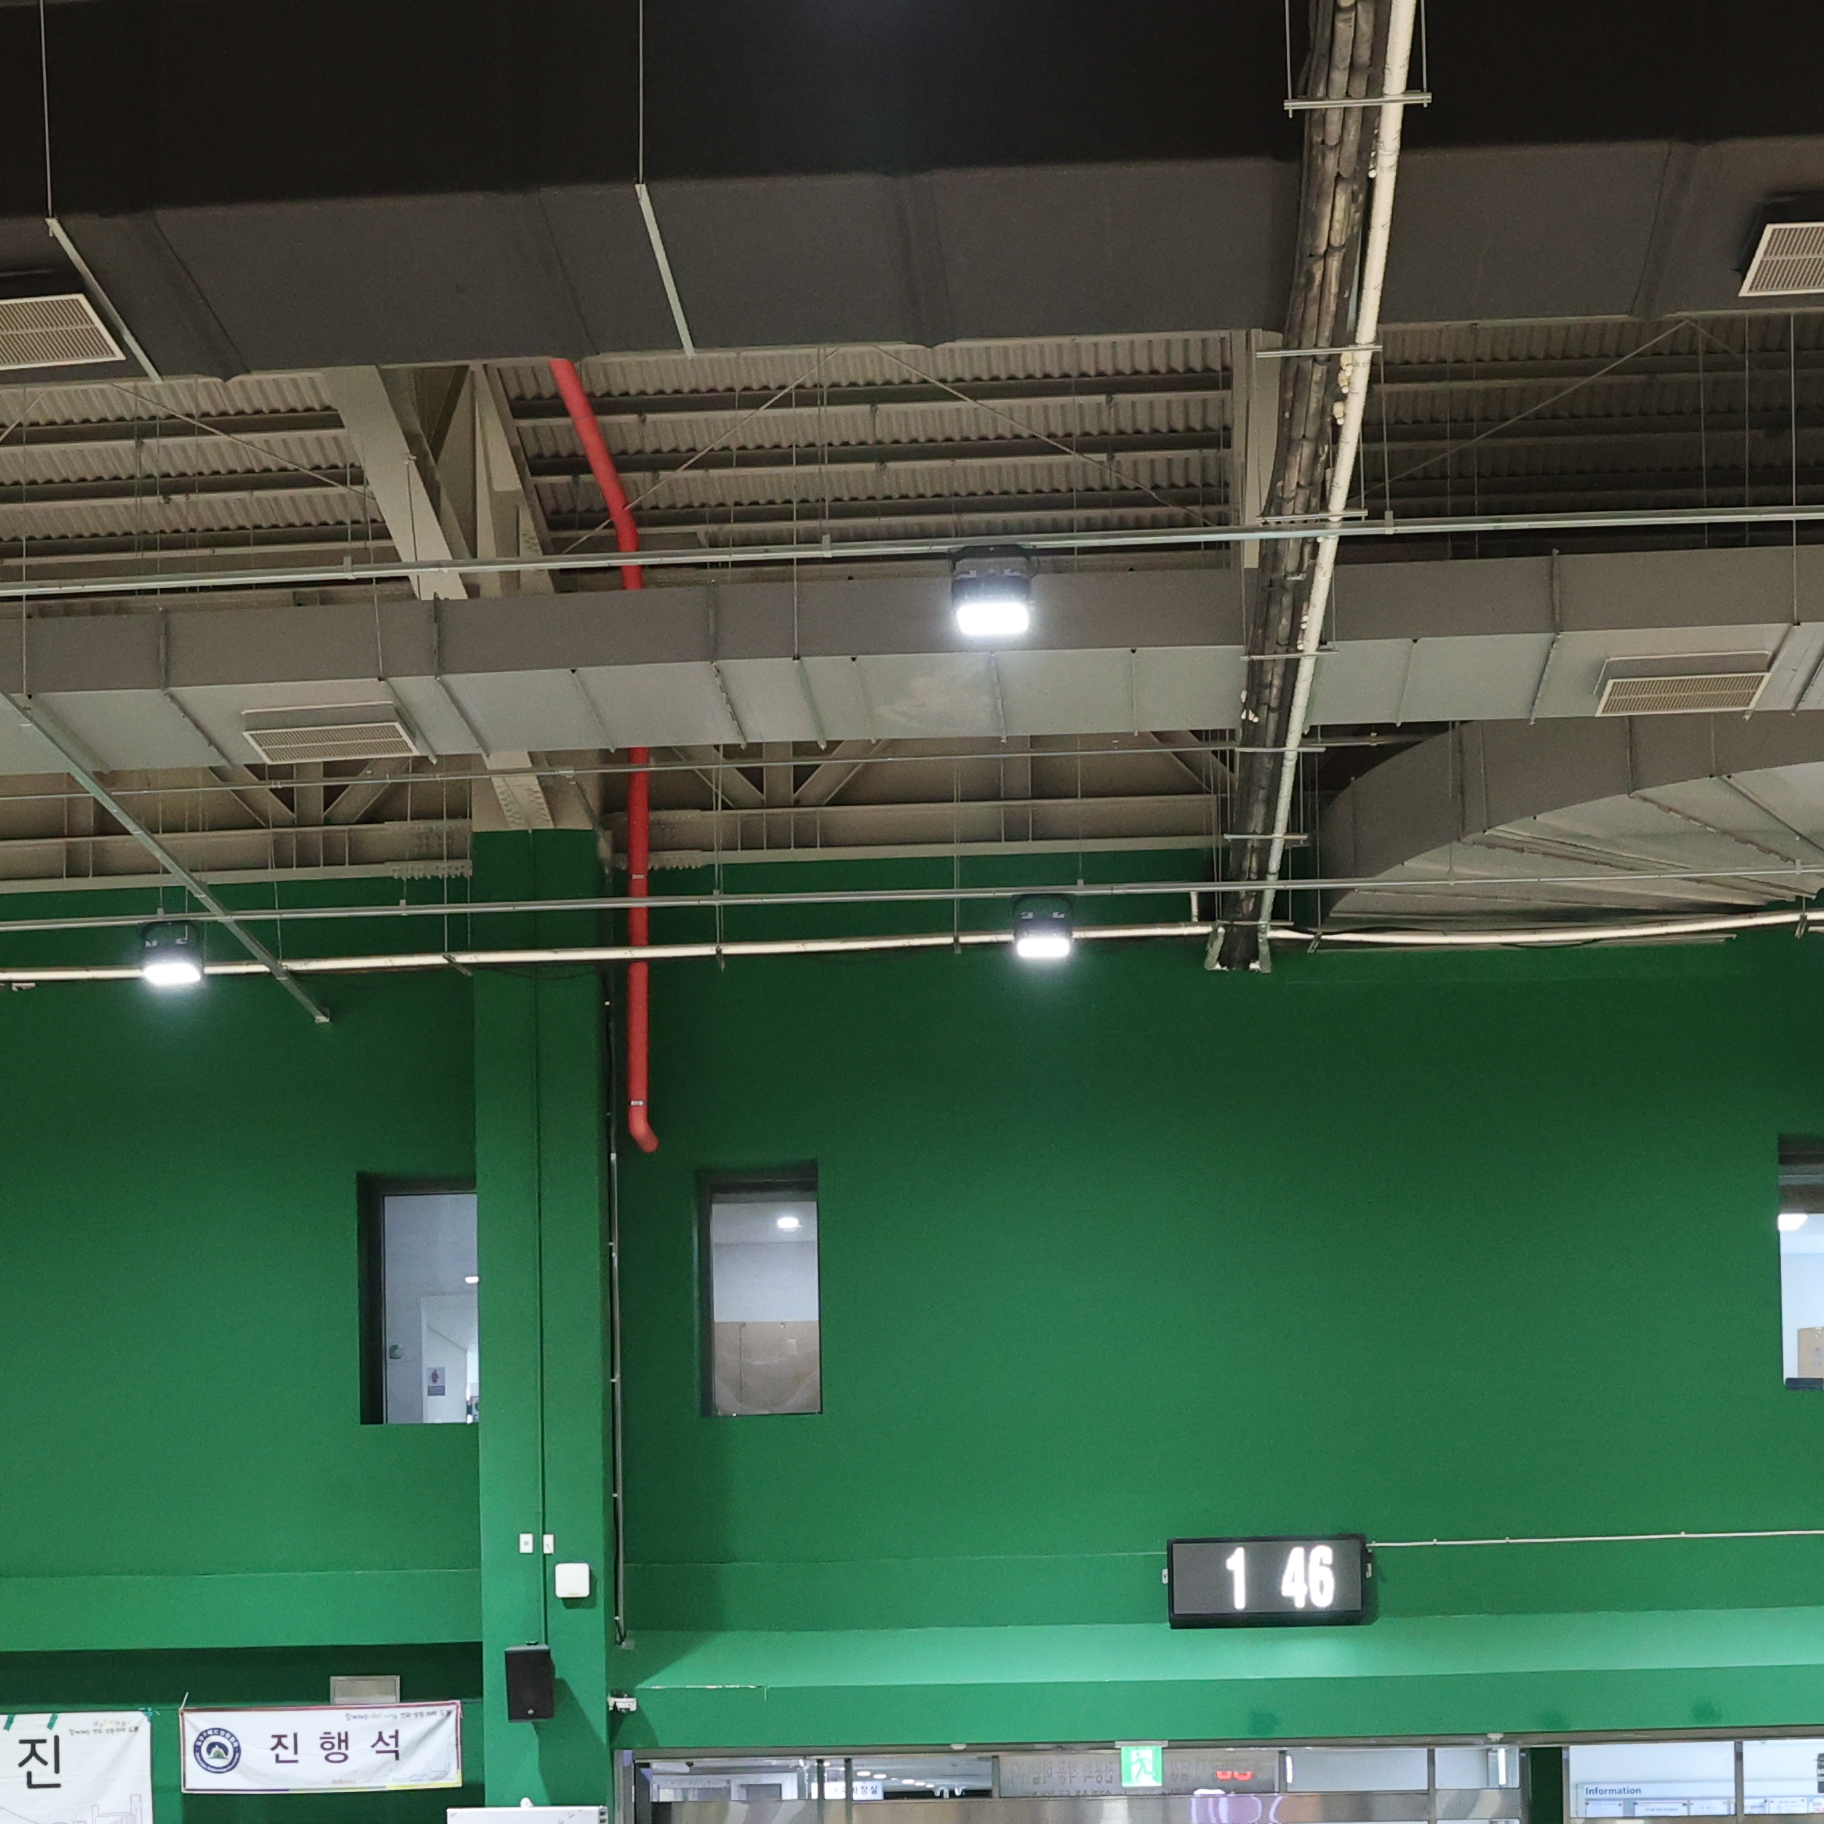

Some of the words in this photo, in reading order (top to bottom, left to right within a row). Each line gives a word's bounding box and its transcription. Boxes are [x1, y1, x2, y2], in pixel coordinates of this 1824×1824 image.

[1225, 1546, 1247, 1609] 1
[1281, 1545, 1336, 1608] 46
[270, 1729, 401, 1764] 진행석
[1585, 1786, 1642, 1796] Information
